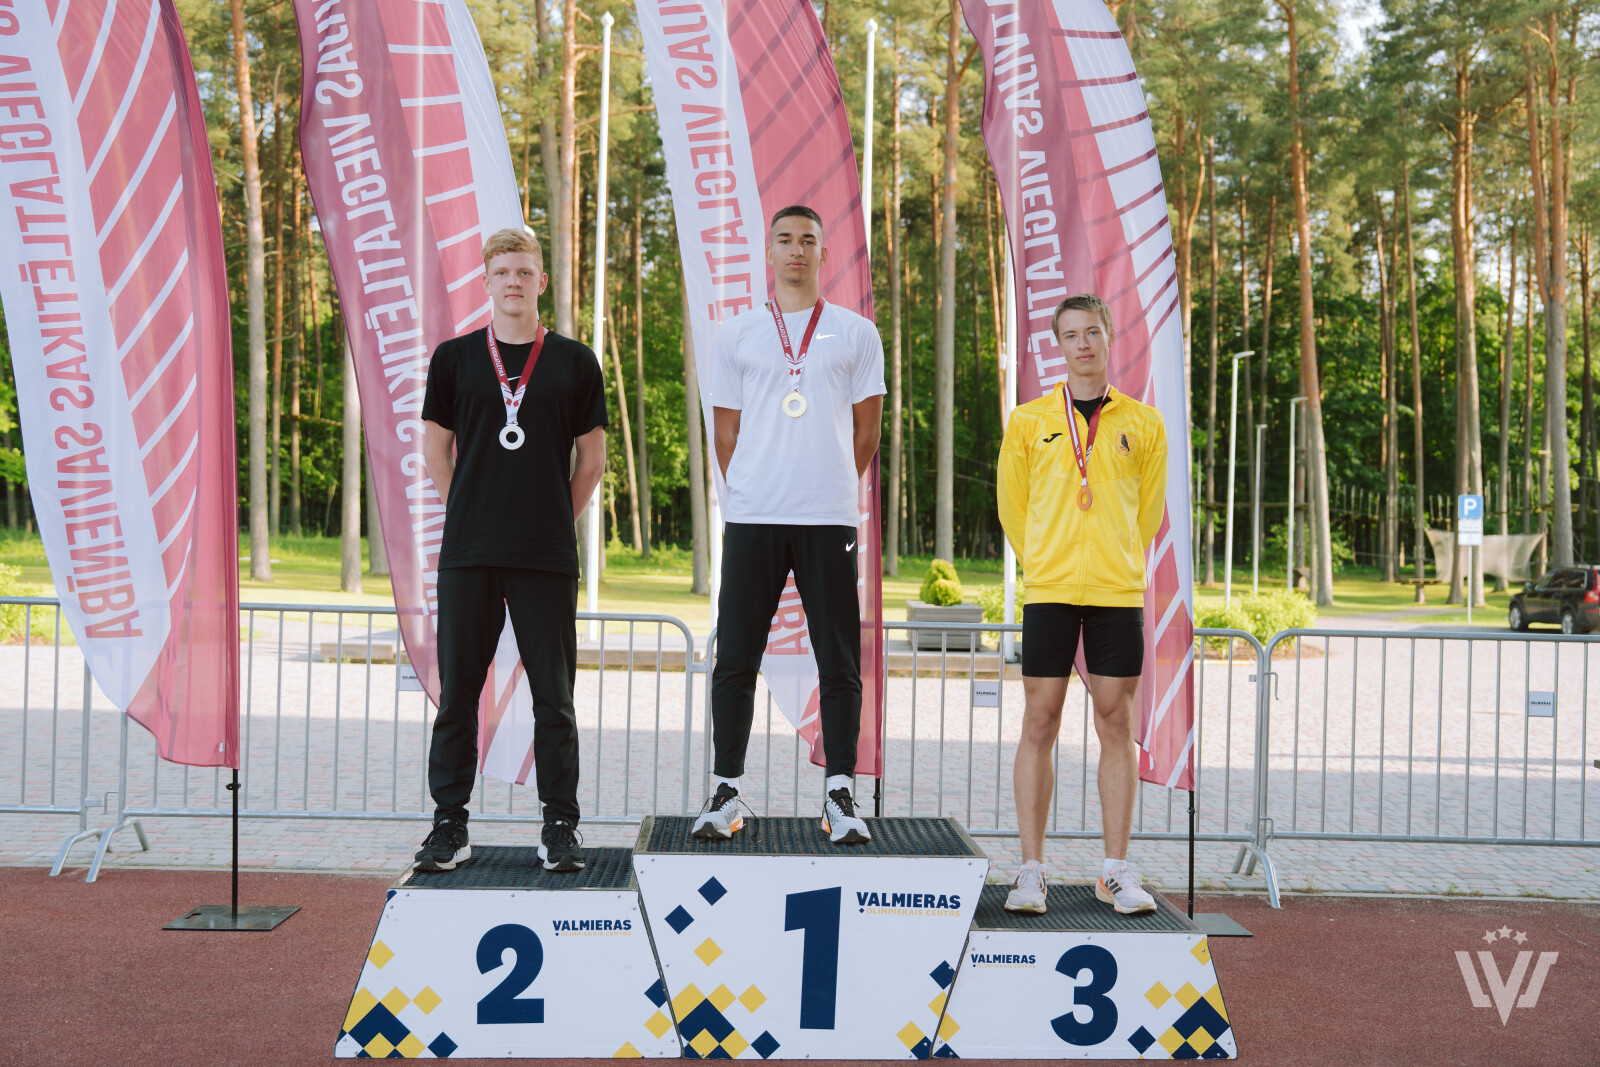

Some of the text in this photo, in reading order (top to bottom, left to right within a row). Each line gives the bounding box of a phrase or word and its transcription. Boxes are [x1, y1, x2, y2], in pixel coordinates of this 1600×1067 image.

[1464, 498, 1477, 516] P
[856, 892, 961, 909] VALMIERAS
[866, 908, 961, 917] OLIMPISKAIS CENTRS
[552, 919, 632, 931] VALMIERAS
[784, 886, 842, 1030] 1
[970, 954, 1036, 964] VALMIERAS
[476, 923, 544, 1025] 2
[1050, 945, 1118, 1046] 3
